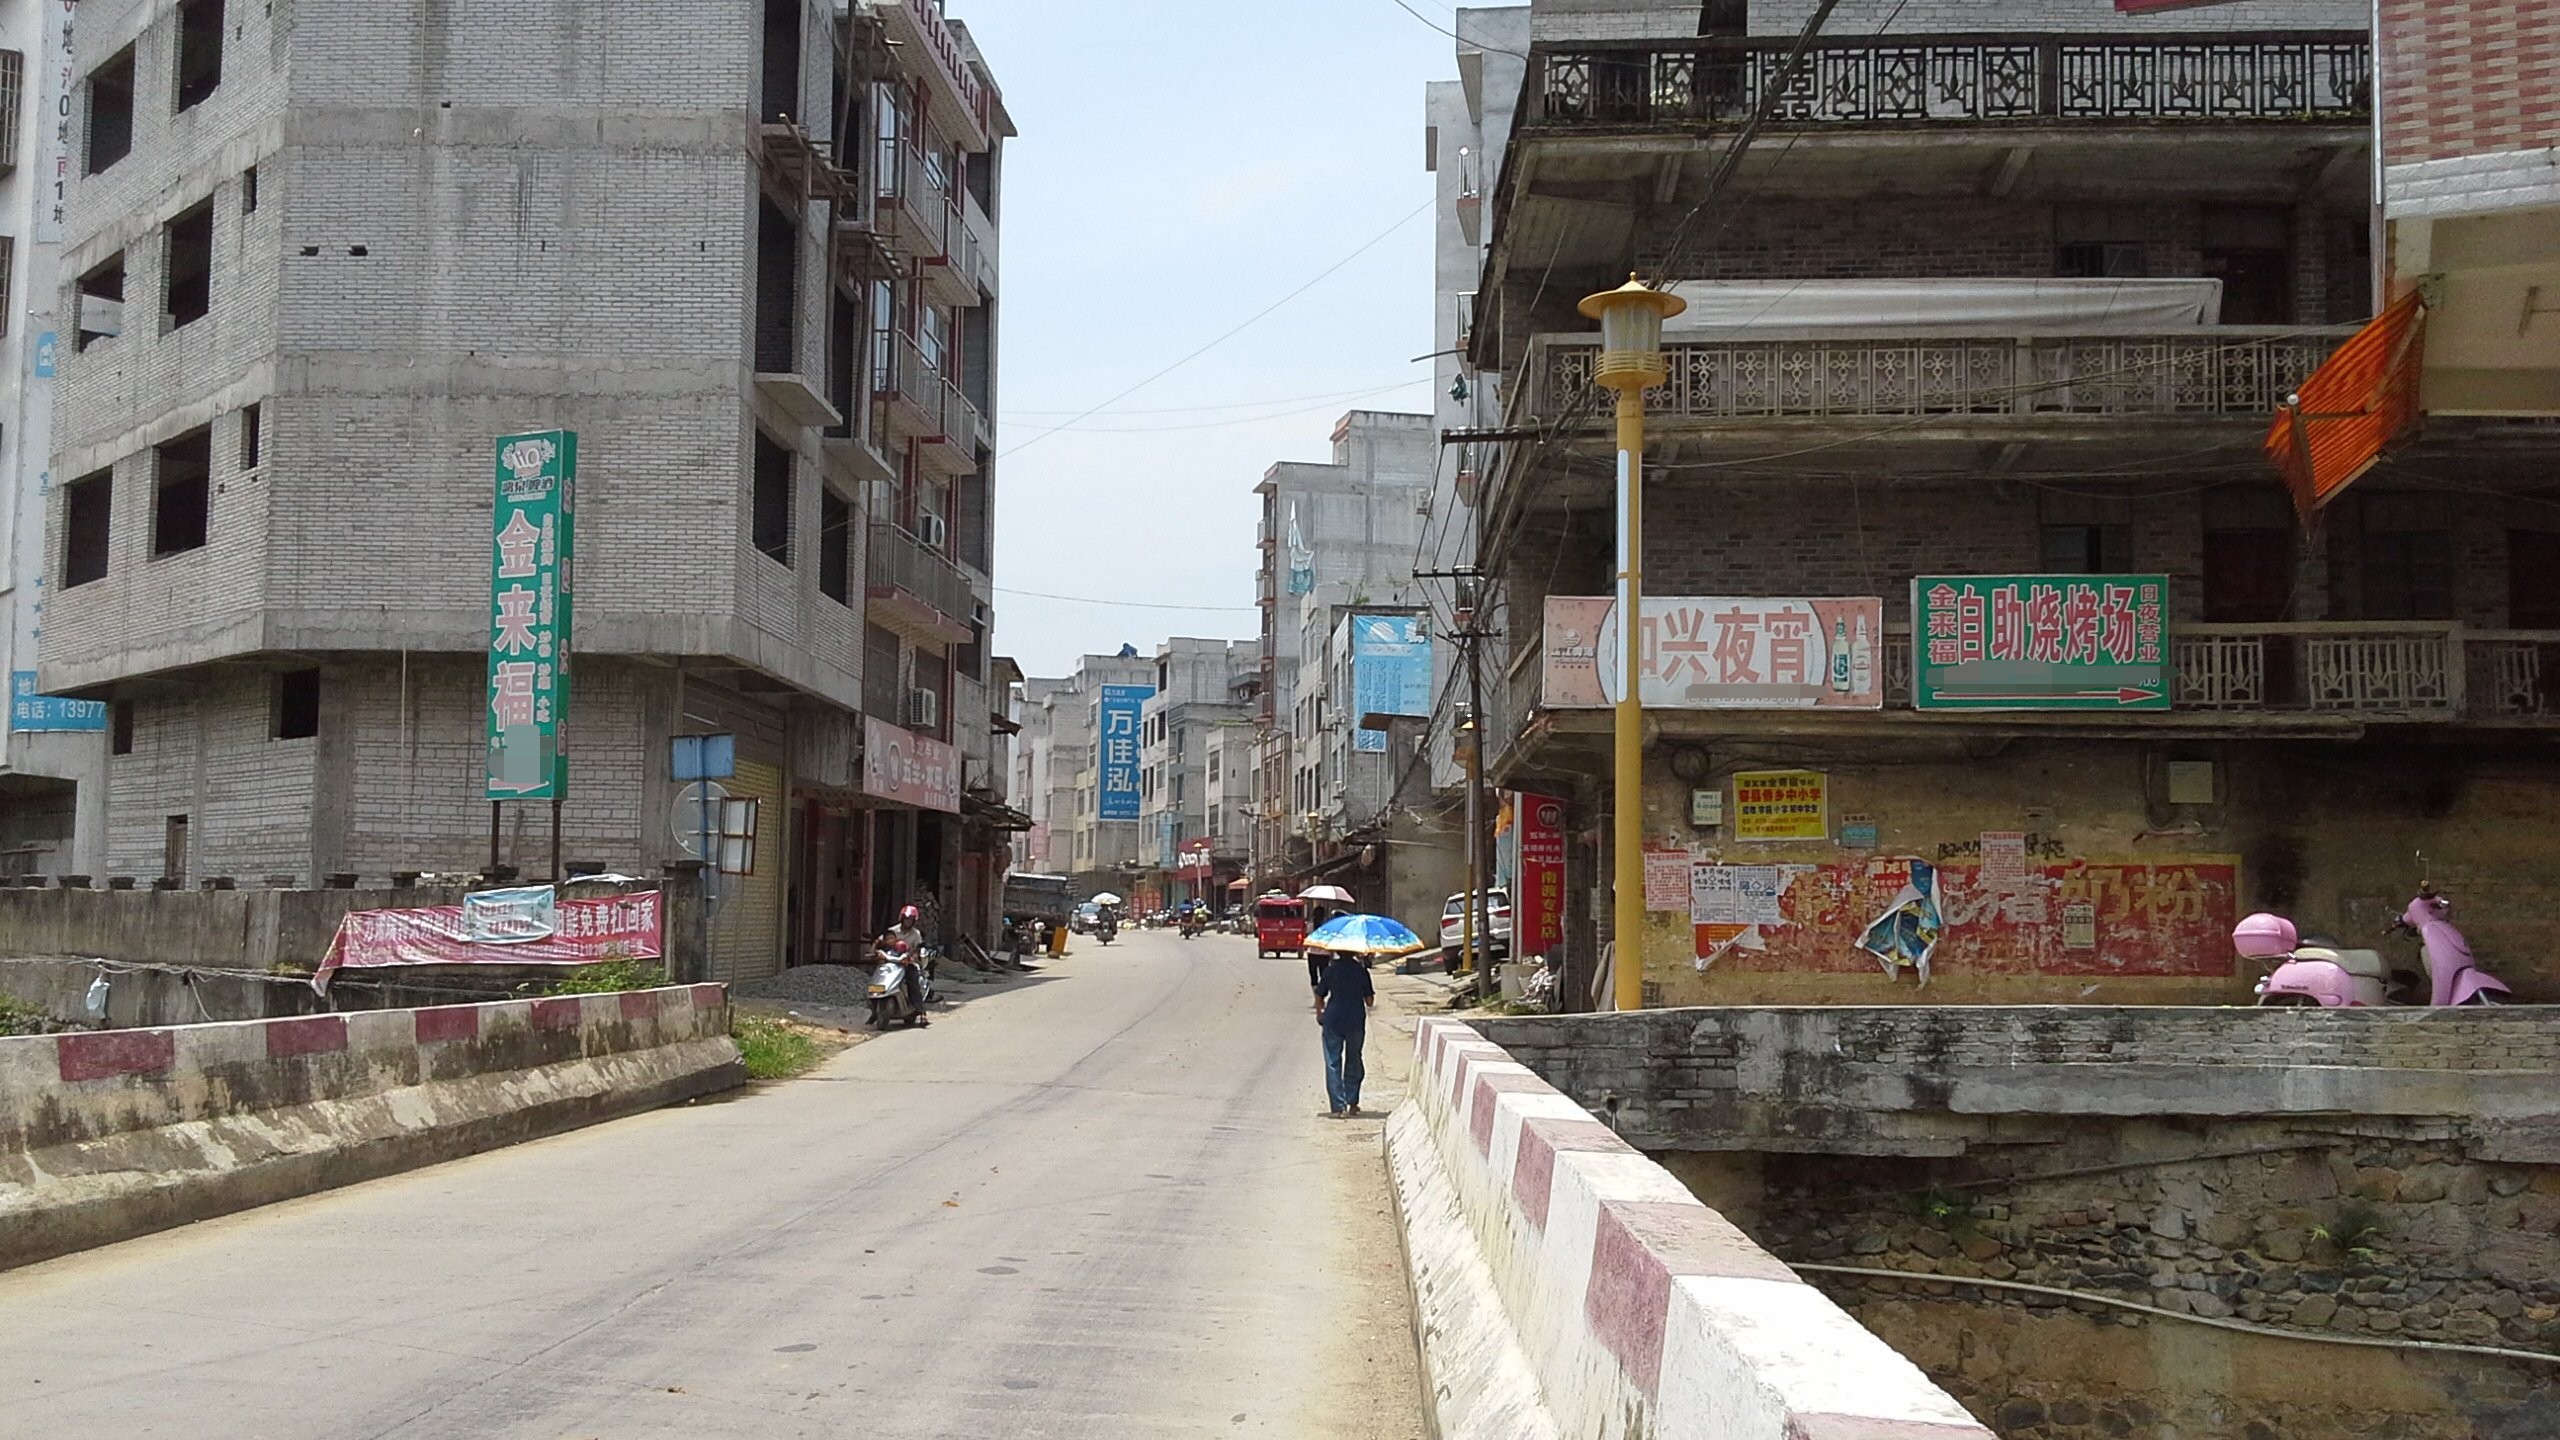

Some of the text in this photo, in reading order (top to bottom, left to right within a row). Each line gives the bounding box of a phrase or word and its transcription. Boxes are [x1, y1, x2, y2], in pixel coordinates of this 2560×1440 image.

[491, 508, 541, 733] 金来福
[1927, 583, 1957, 665] 金来福
[1957, 583, 2135, 664] 自助烧烤场
[2137, 584, 2160, 663] 日夜营业
[1106, 709, 1133, 792] 万佳泓
